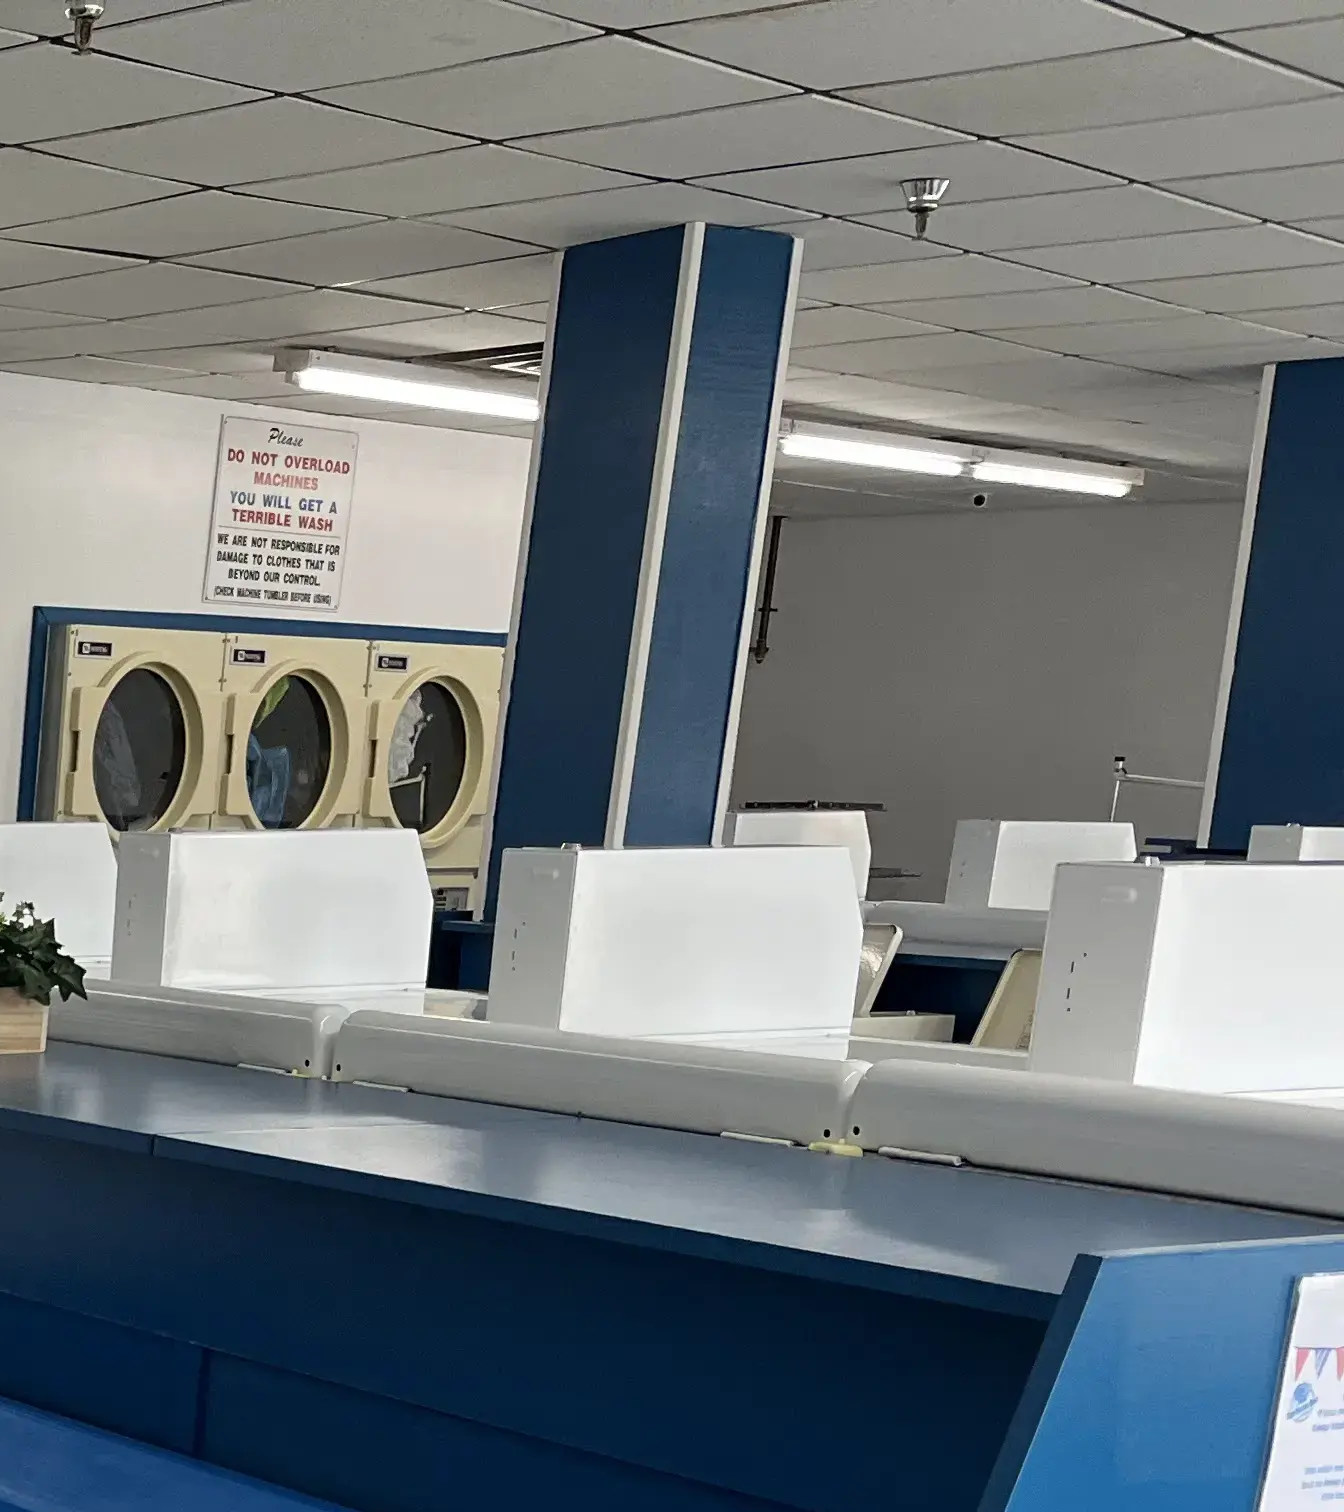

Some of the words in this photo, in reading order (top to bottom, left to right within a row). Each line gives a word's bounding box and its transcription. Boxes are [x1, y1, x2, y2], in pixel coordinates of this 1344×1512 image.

[268, 428, 305, 447] Please
[228, 449, 244, 462] DO
[252, 452, 278, 466] NOT
[284, 455, 350, 474] OVERLOAD
[254, 472, 319, 490] MACHINES
[230, 491, 255, 505] YOU
[263, 495, 292, 509] WILL
[299, 499, 323, 512] GET
[329, 502, 338, 513] A
[232, 509, 291, 527] TERRIBLE
[298, 516, 333, 531] WASH
[217, 534, 229, 545] WE
[232, 535, 247, 547] ARE
[251, 537, 267, 548] NOT
[271, 539, 323, 553] RESPONSIBLE
[325, 544, 340, 555] FOR
[217, 551, 248, 564] DAMAGE
[252, 555, 263, 565] TO
[267, 556, 301, 568] CLOTHES
[305, 559, 324, 570] THAT
[328, 561, 335, 571] IS
[228, 569, 260, 581] BEYOND
[264, 572, 280, 583] OUR
[237, 588, 261, 599] MACHINE
[291, 592, 311, 603] BEFORE
